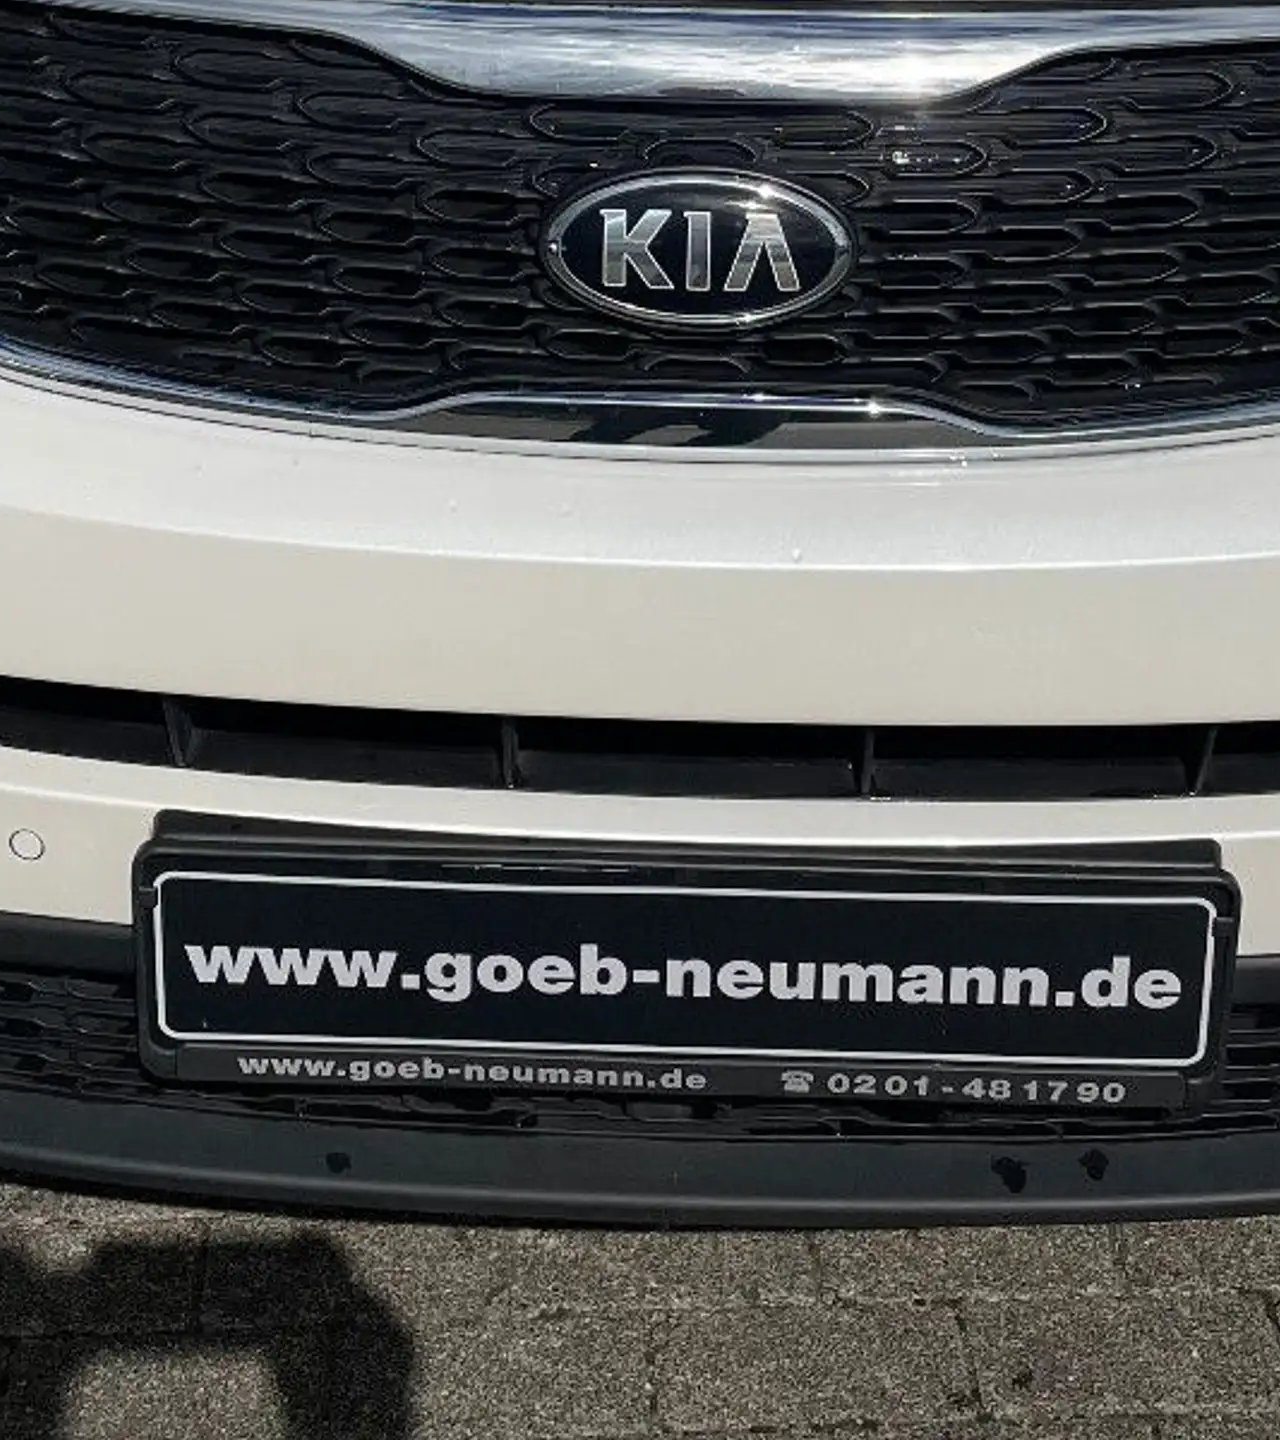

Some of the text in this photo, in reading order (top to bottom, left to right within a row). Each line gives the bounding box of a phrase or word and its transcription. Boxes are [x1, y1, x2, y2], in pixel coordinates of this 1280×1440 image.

[599, 207, 802, 293] KIA
[183, 943, 1183, 1009] www.goeb-neumann.de
[237, 1056, 707, 1090] www.goeb-neumann.de
